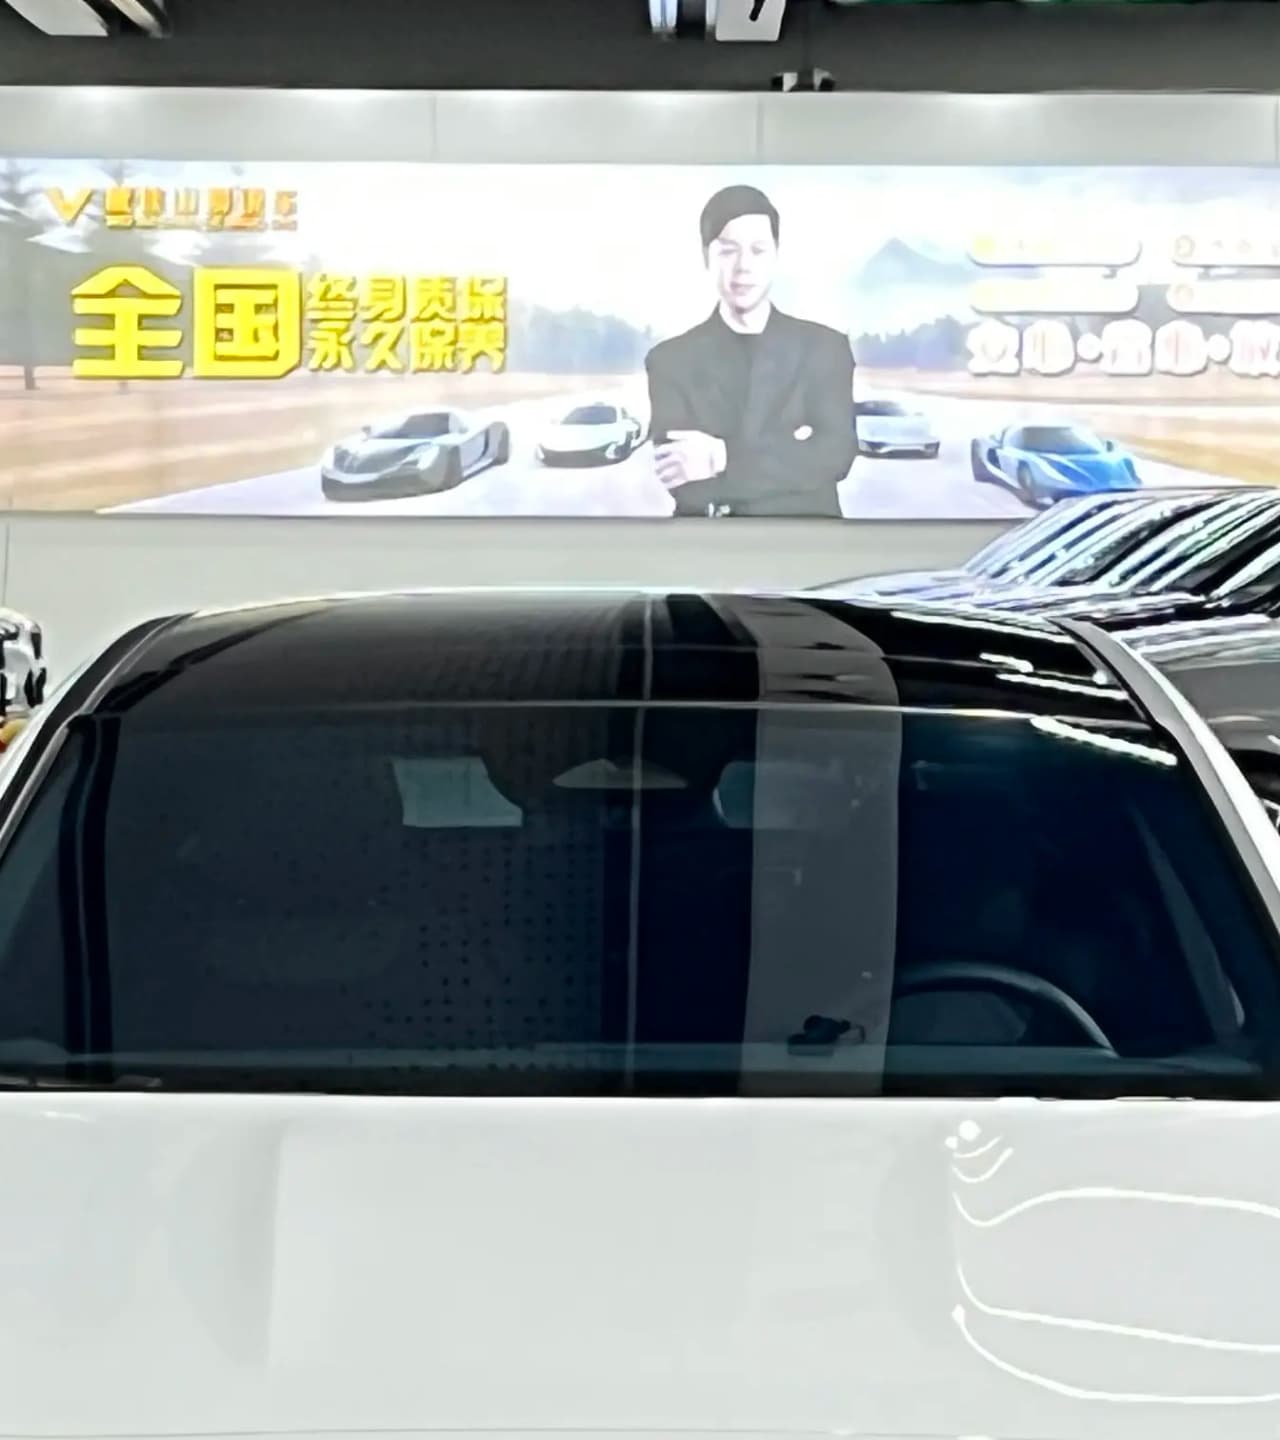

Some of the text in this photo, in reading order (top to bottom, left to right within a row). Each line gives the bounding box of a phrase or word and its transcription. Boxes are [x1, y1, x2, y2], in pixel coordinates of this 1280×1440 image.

[70, 264, 302, 379] 全国
[305, 273, 508, 322] 终身质保
[306, 320, 507, 373] 永久保养
